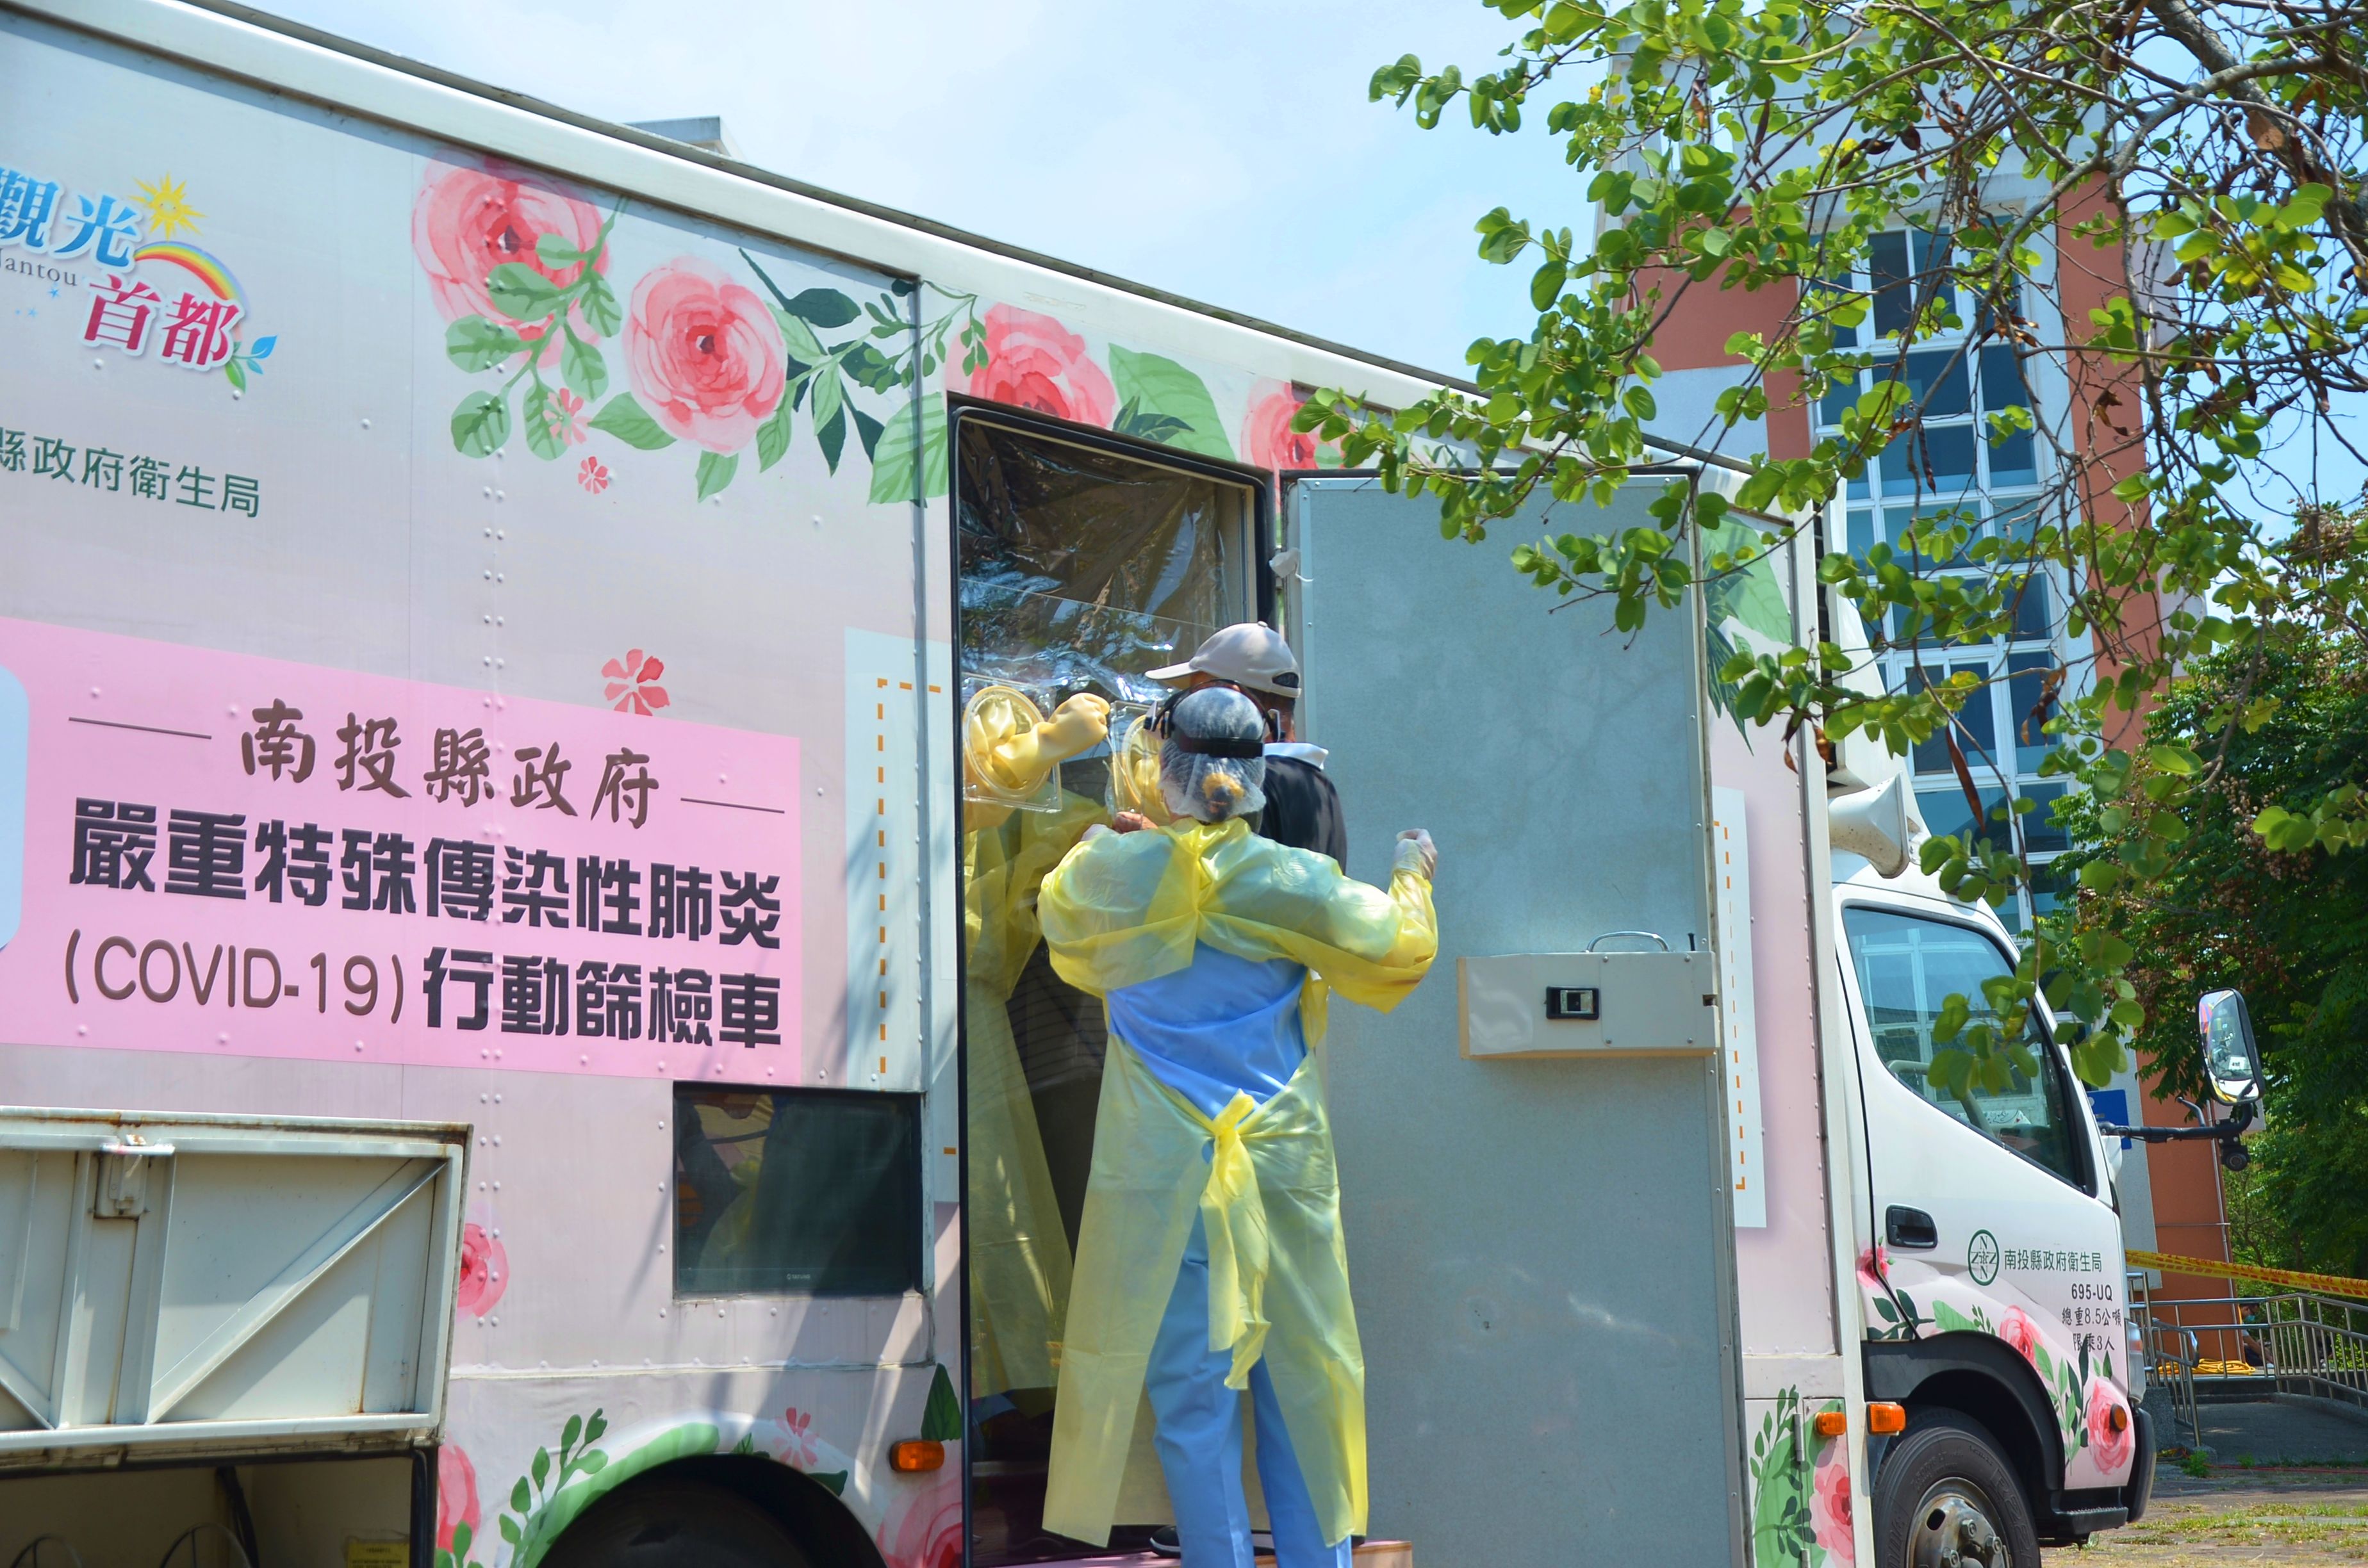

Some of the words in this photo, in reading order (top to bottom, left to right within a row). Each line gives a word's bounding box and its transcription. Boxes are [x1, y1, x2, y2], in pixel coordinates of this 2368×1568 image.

[83, 274, 244, 366] 首都
[241, 698, 659, 829] 南投縣政府
[69, 796, 781, 949] 嚴重特殊傳染性肺炎
[2004, 1249, 2102, 1272] 南投縣政府衛生局
[2071, 1284, 2112, 1302] 695-UQ
